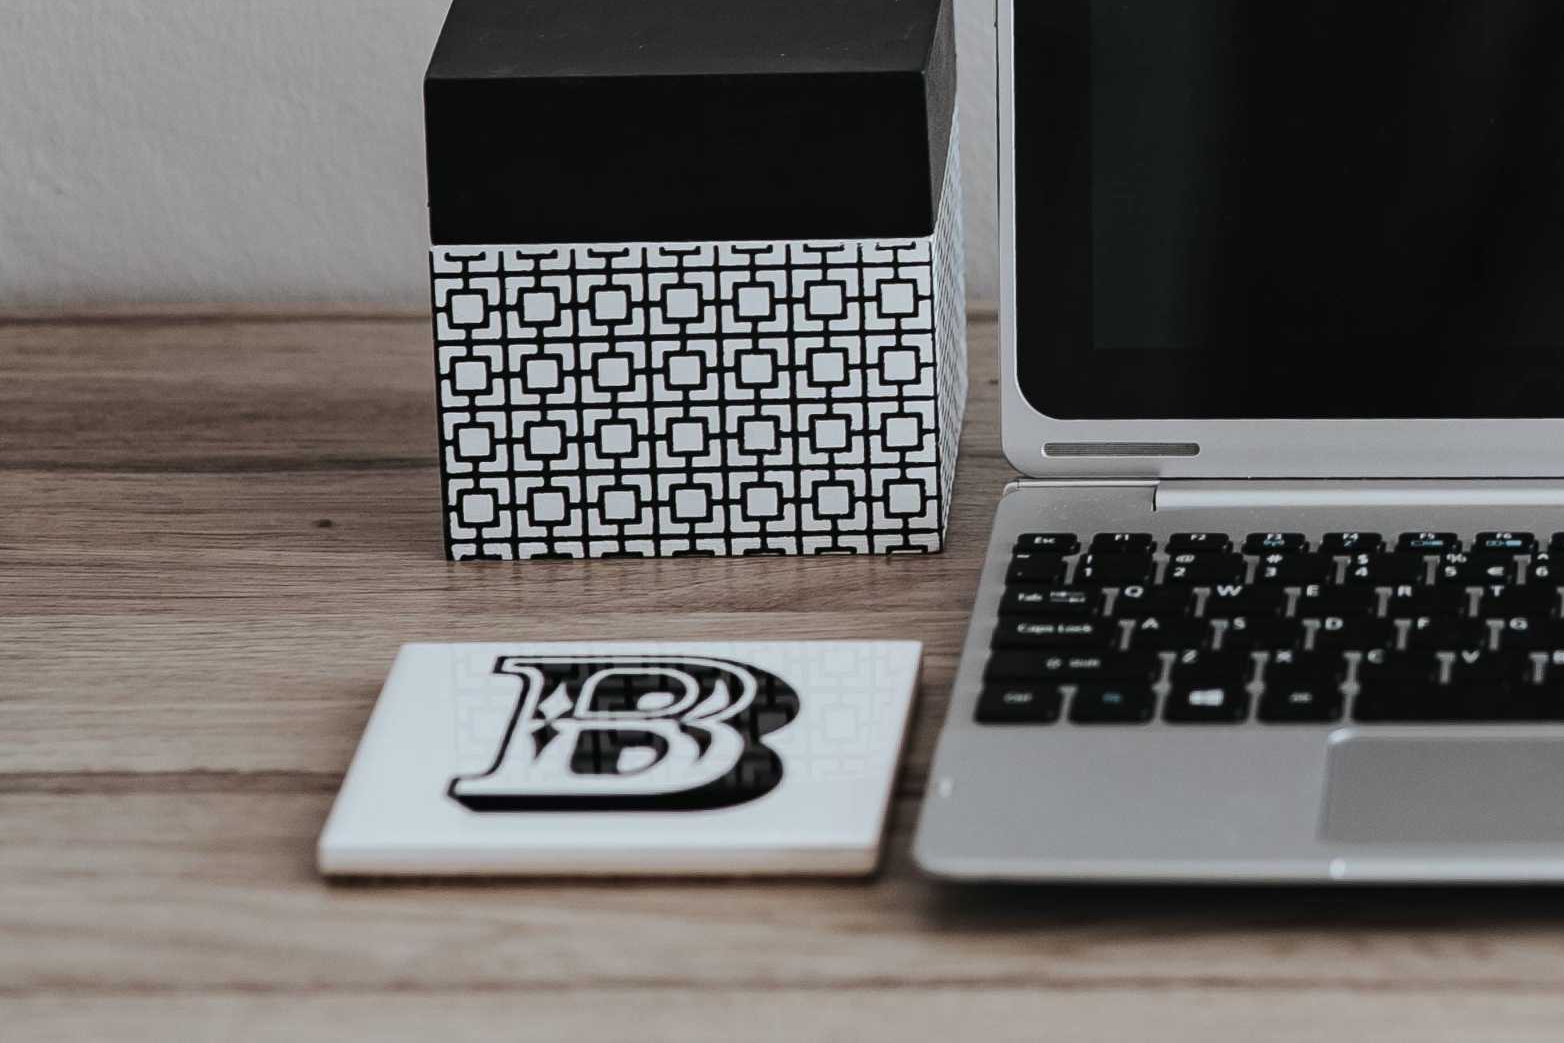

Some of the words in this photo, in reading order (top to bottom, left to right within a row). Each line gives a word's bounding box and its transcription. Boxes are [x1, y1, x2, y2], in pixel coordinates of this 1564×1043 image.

[1124, 585, 1144, 598] Q
[1216, 585, 1243, 597] W
[1306, 585, 1320, 597] E
[1397, 585, 1412, 597] R
[1490, 585, 1504, 597] T
[1141, 617, 1160, 630] A
[1233, 617, 1246, 630] S
[1325, 617, 1344, 630] D
[1417, 616, 1430, 630] F
[1509, 617, 1528, 630] G
[1367, 649, 1384, 664] C
[1461, 649, 1480, 663] V
[446, 656, 800, 813] B
